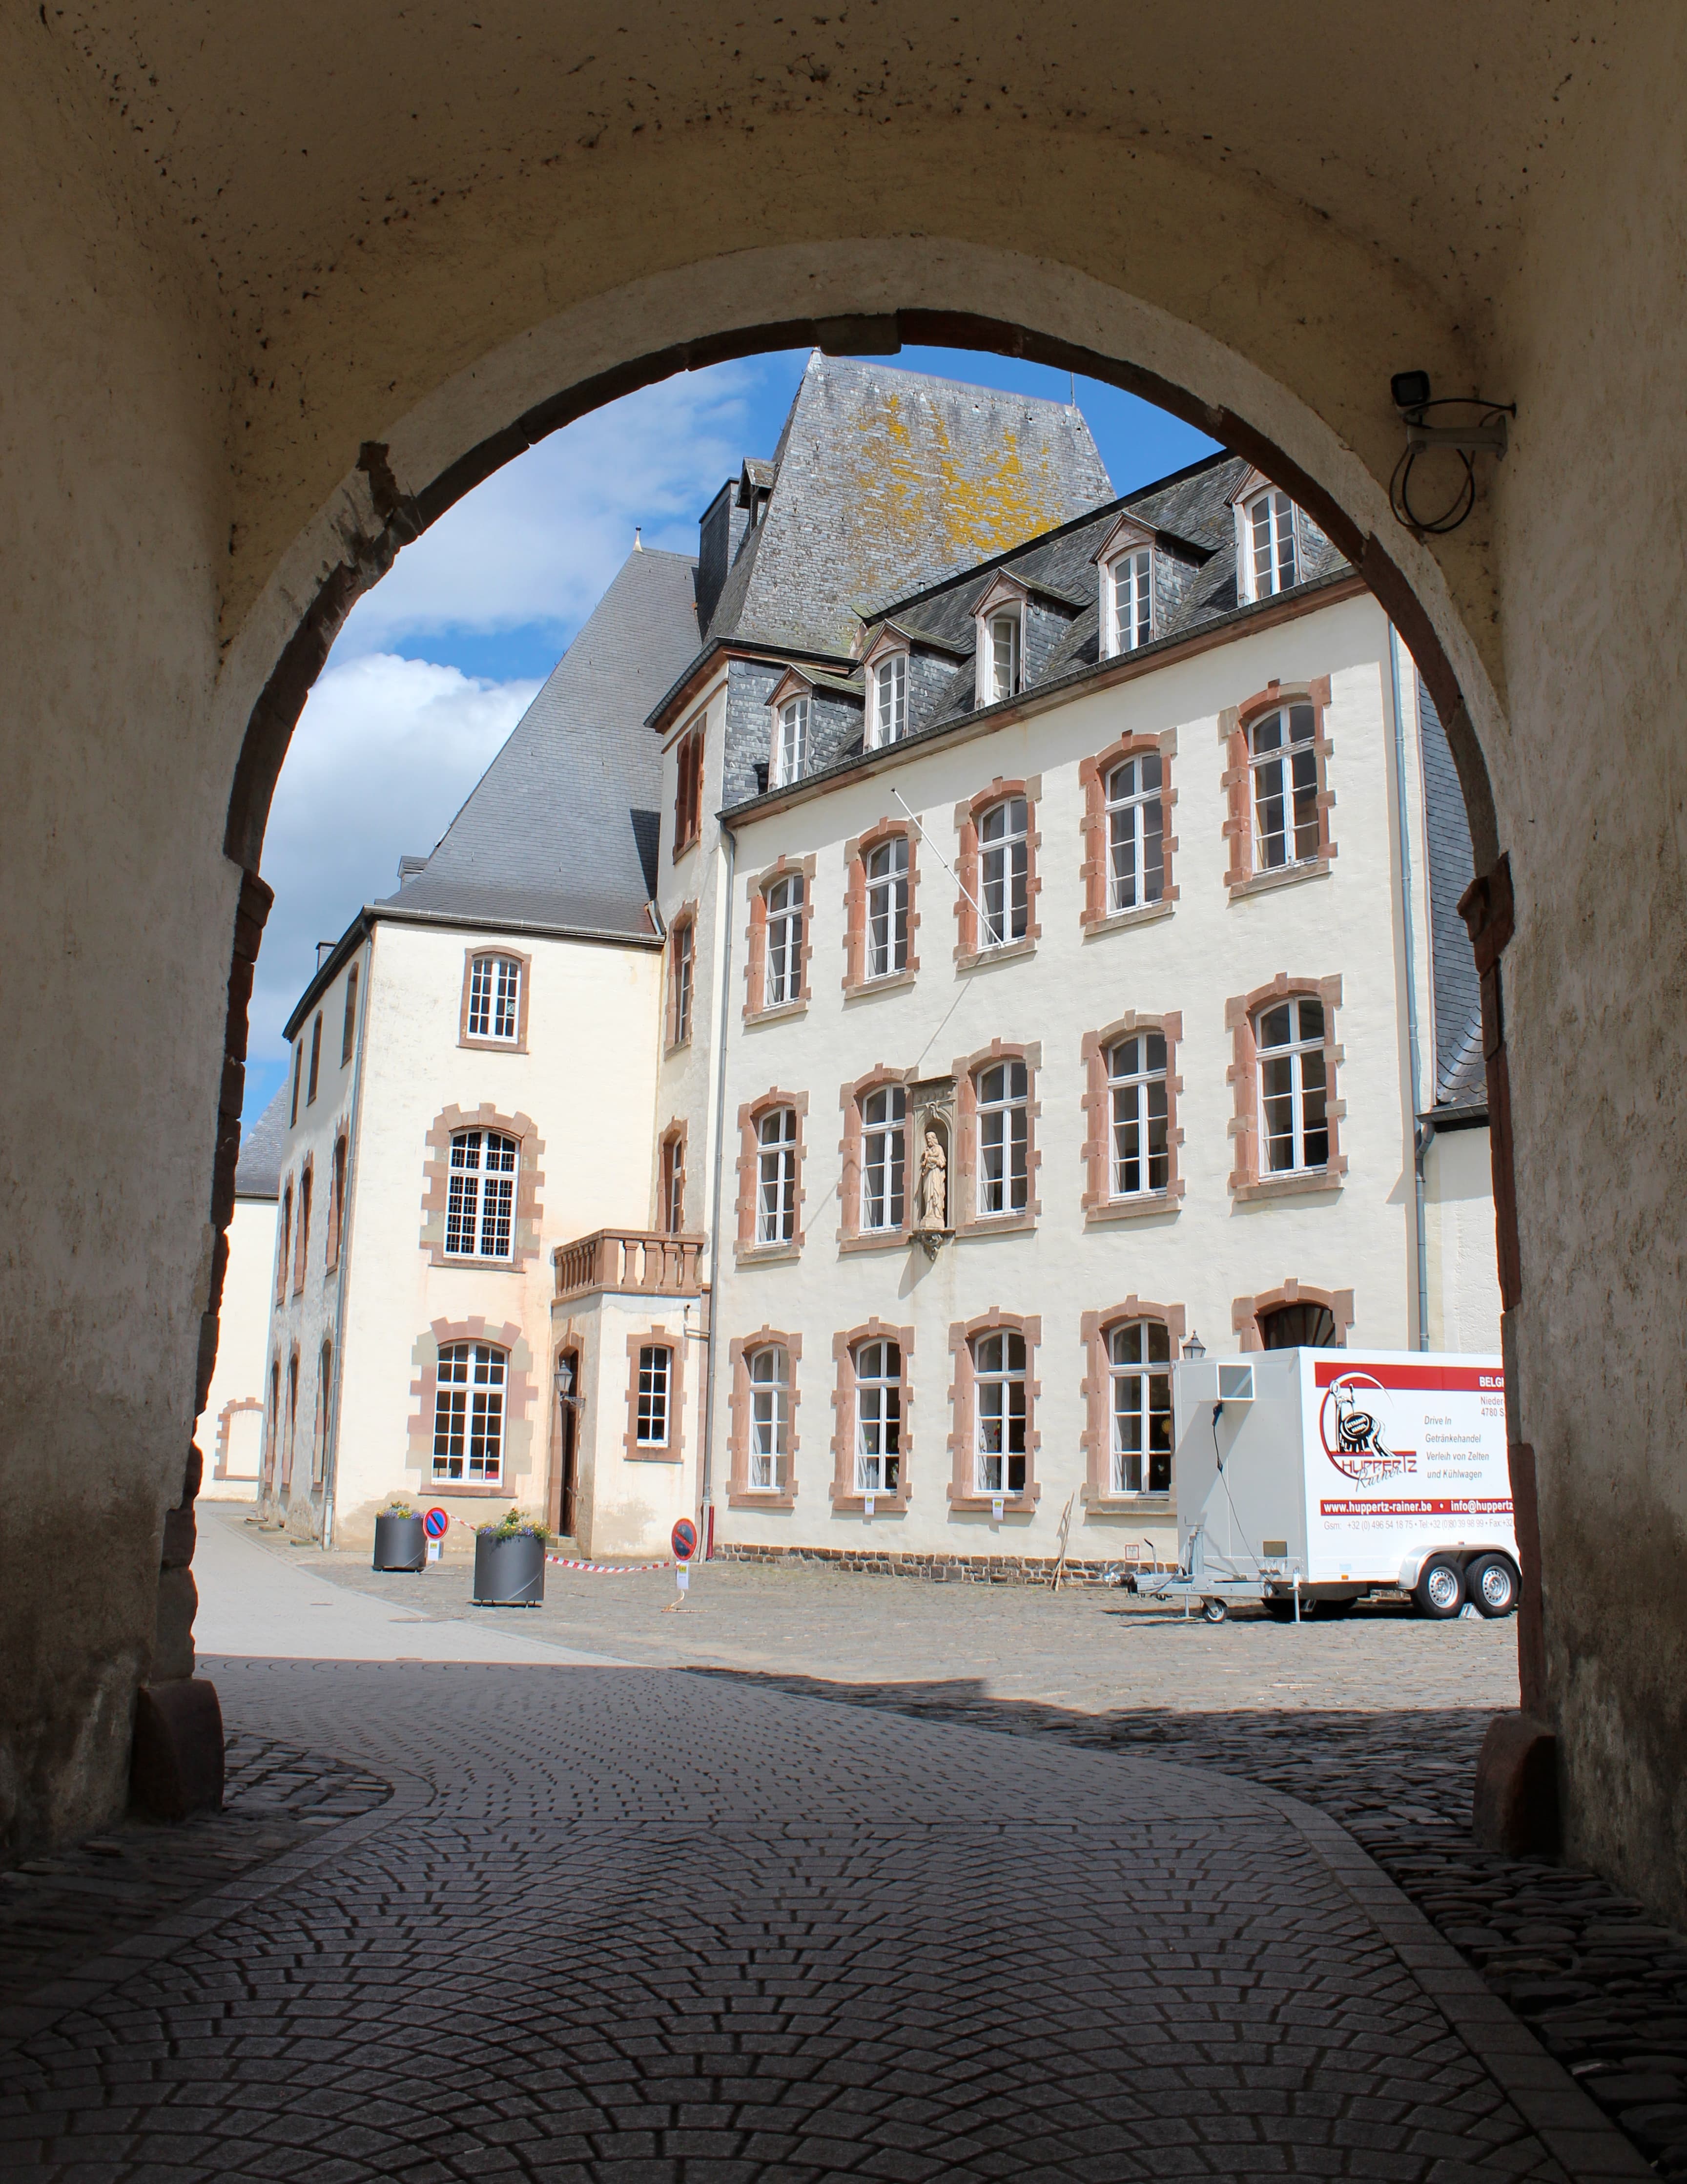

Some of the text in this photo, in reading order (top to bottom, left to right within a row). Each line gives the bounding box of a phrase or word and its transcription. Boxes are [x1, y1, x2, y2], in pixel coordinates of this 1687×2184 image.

[1481, 1407, 1497, 1416] 4780
[1424, 1415, 1452, 1425] Drive In
[1425, 1433, 1481, 1443] Getränkehandel
[1426, 1451, 1451, 1460] Verleih
[1468, 1451, 1489, 1460] Zelten
[1342, 1456, 1417, 1473] HUPPERTZ
[1427, 1469, 1482, 1480] und Kühlwagen
[1323, 1500, 1513, 1515] www.huppertz-rainer.be info@huppertz
[1324, 1520, 1342, 1530] Gsm:
[1347, 1520, 1359, 1529] +32
[1361, 1520, 1370, 1531] (0)
[1372, 1520, 1384, 1529] 496
[1385, 1520, 1393, 1529] 54
[1396, 1520, 1403, 1529] 18
[1405, 1519, 1413, 1529] 75
